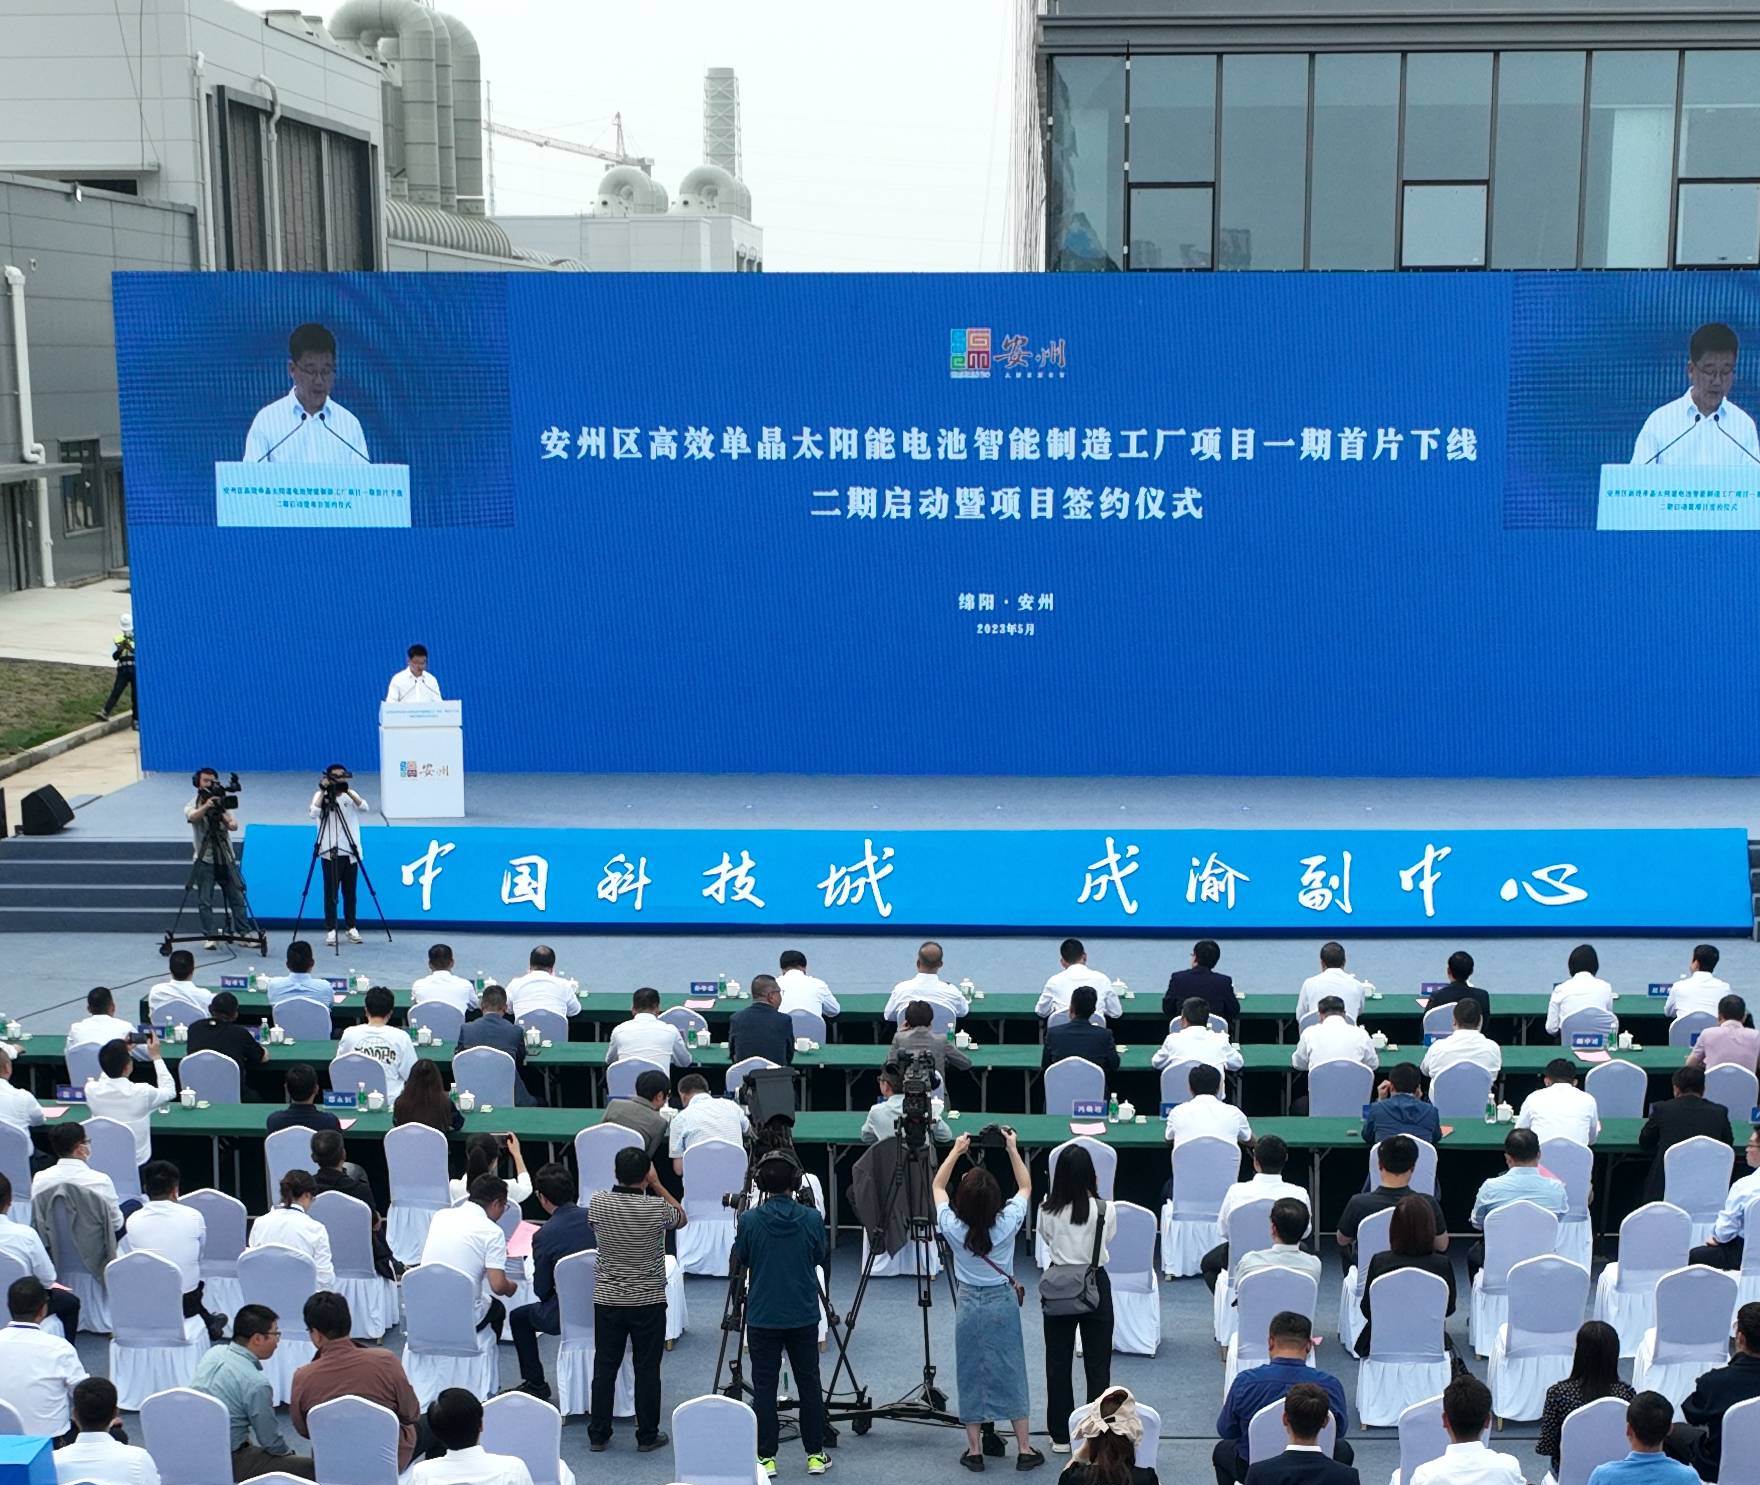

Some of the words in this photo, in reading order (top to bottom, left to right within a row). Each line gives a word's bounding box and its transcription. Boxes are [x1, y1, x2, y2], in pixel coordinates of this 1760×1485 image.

[993, 333, 1066, 369] 安州
[540, 425, 1478, 461] 安州区高效单晶太阳能电池智能制造工厂项目一期首片下线
[810, 486, 1204, 520] 二期启动暨项目签约仪式
[976, 622, 1035, 636] 2023年5月
[401, 838, 896, 918] 中国科技城
[1076, 836, 1588, 917] 成渝副中心
